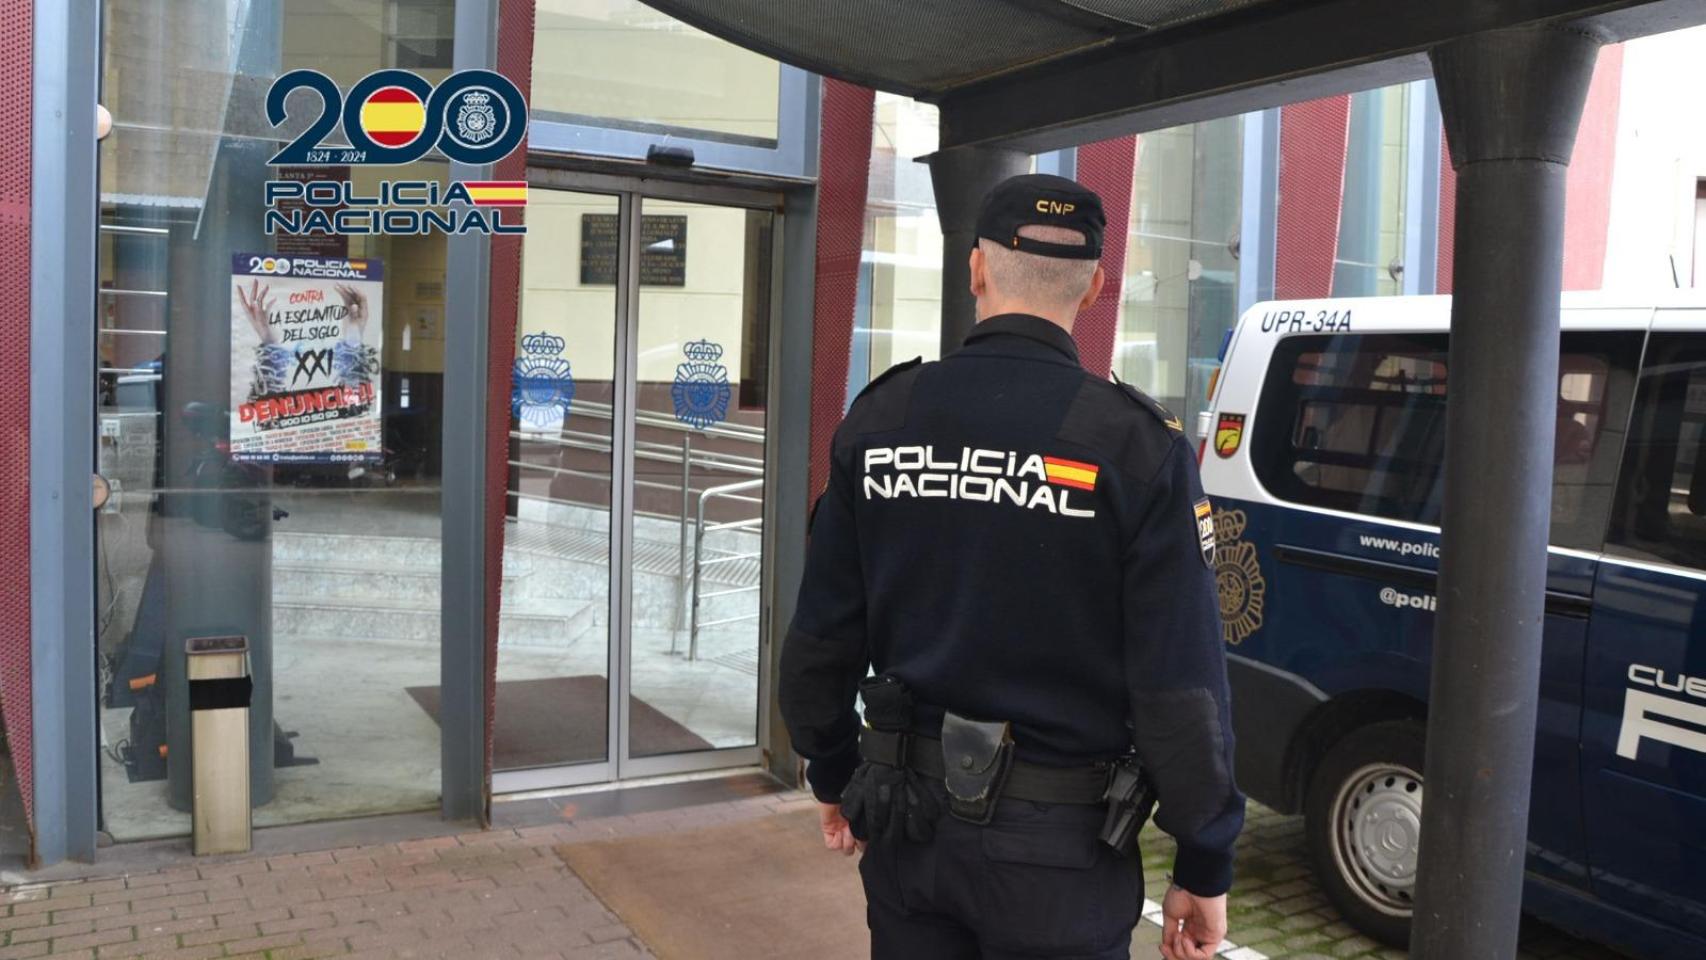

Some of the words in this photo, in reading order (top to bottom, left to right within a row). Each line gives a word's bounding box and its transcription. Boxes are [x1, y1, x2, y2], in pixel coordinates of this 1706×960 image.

[1036, 199, 1075, 216] CNP
[249, 256, 291, 274] 200
[292, 267, 367, 279] NACIONAL
[289, 290, 324, 304] CONTRA
[269, 311, 282, 325] LA
[285, 305, 349, 324] ESCLAVITUD
[1261, 310, 1352, 333] UPR-34A
[282, 328, 307, 343] DEL
[308, 325, 340, 341] SIGLO
[290, 349, 334, 387] XXI
[863, 473, 1096, 518] NACIONAL
[1380, 587, 1437, 611] @poli
